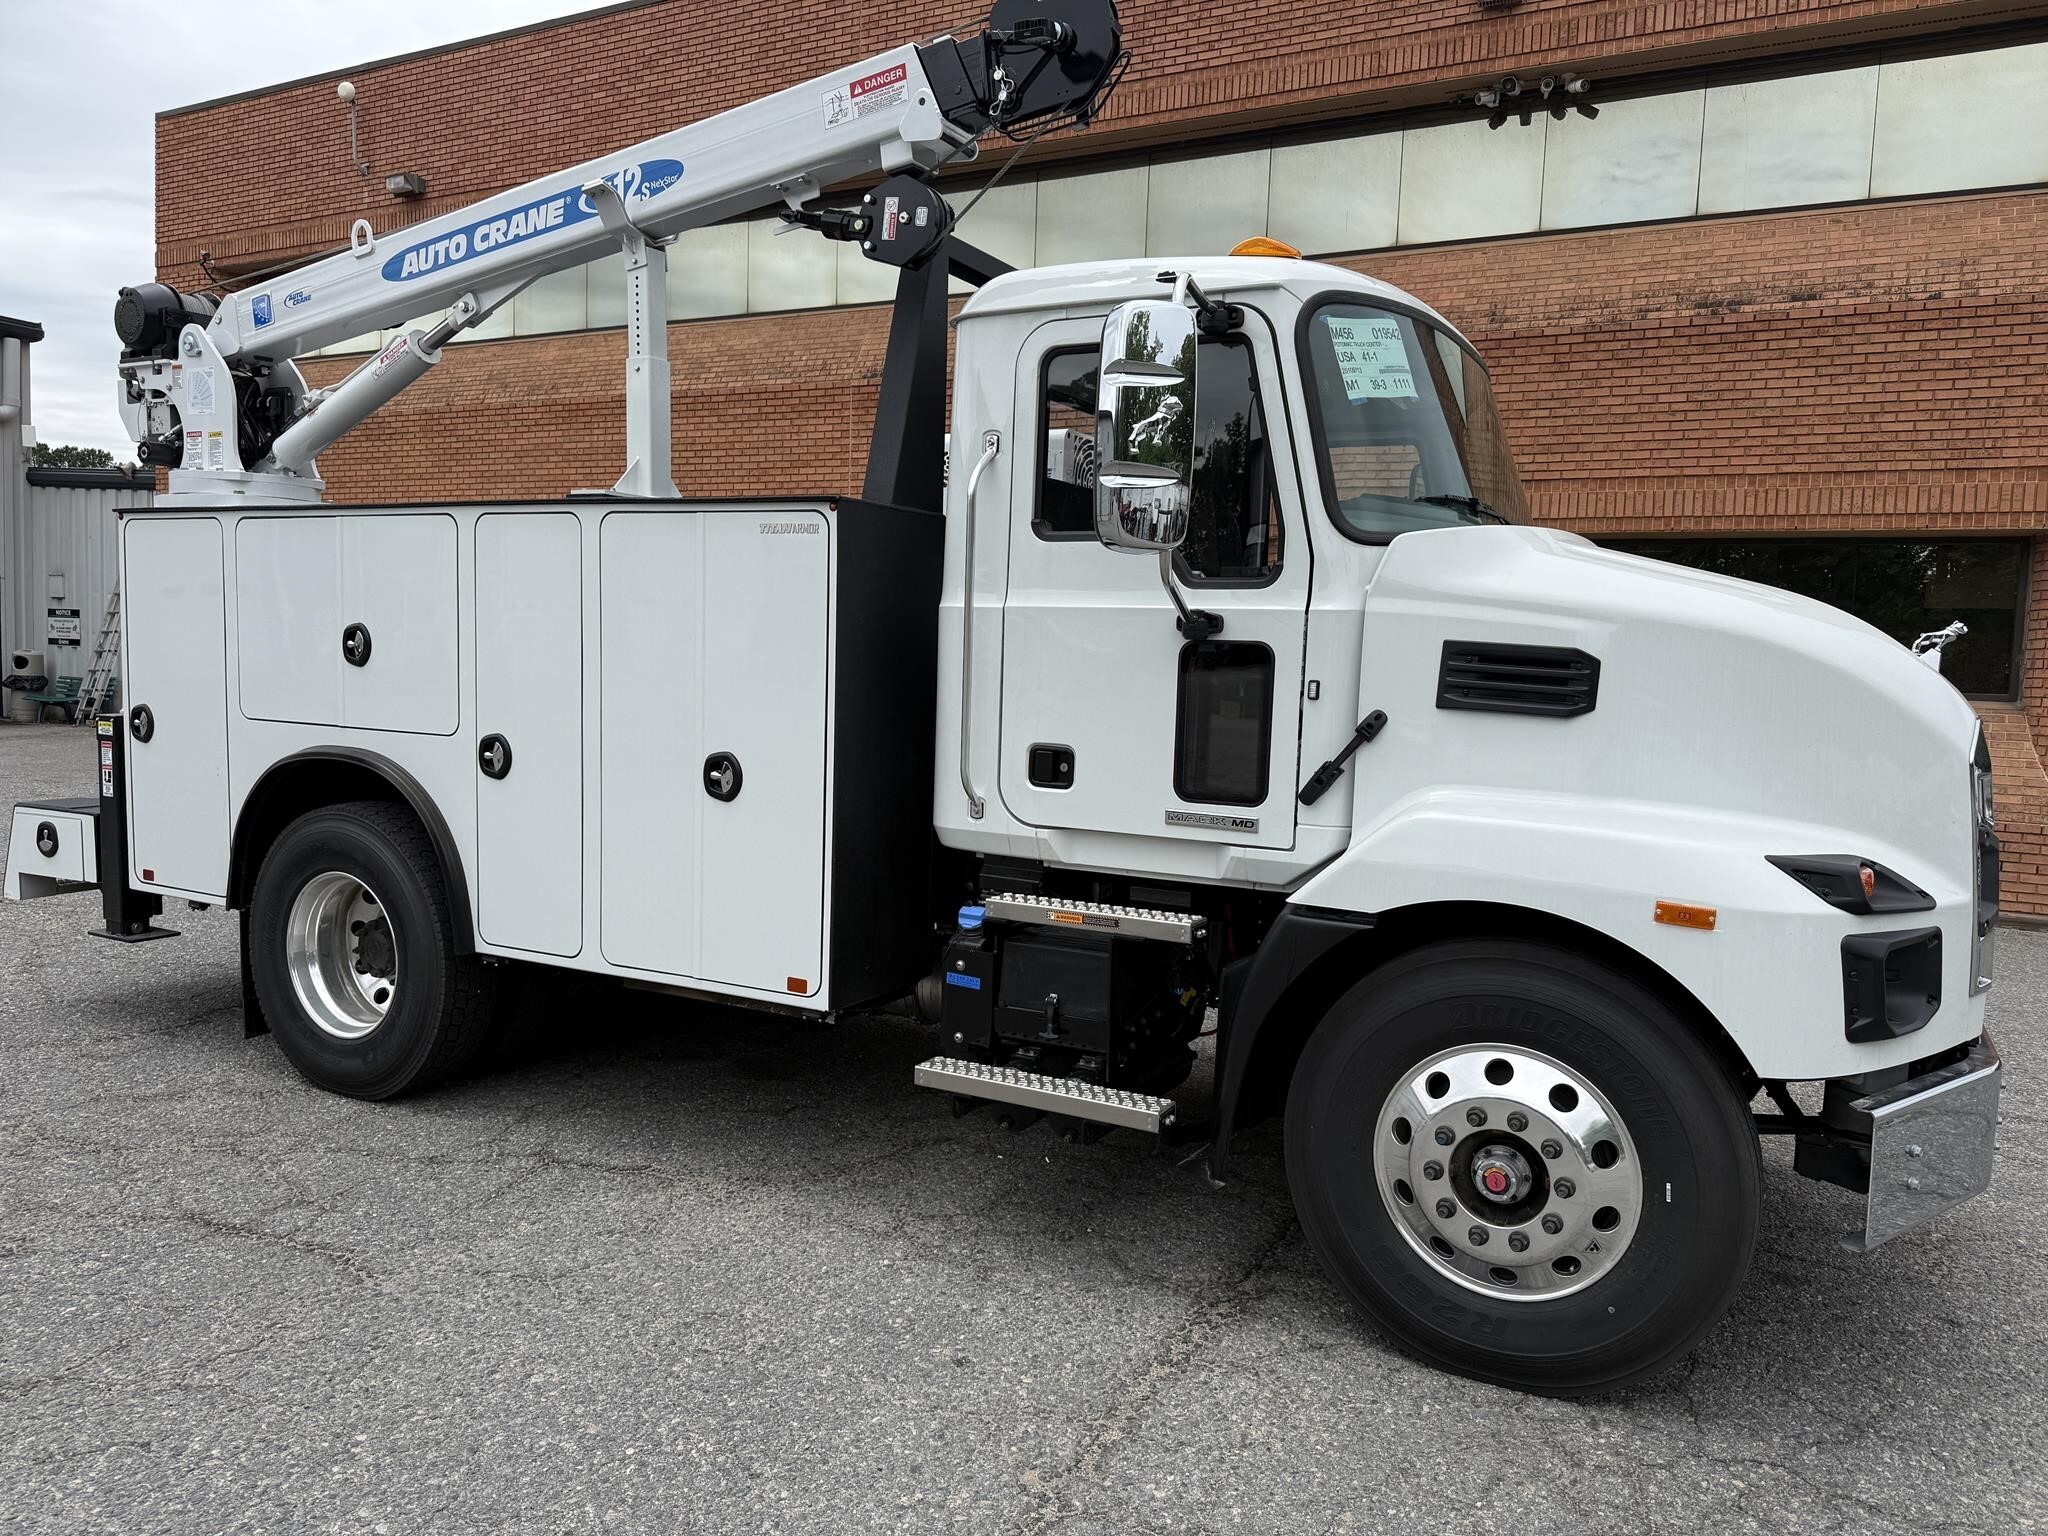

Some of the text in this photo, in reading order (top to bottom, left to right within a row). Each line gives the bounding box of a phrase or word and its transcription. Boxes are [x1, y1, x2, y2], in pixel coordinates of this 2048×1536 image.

[864, 69, 903, 89] DANGER
[400, 232, 468, 279] AUTO
[288, 291, 304, 302] AUTO
[292, 294, 312, 306] CRANE
[1330, 327, 1401, 340] M456 019542
[1336, 351, 1379, 363] USA 41-1
[1345, 379, 1361, 391] M1
[1369, 379, 1388, 390] 39-3
[1167, 812, 1255, 829] MACK MD
[1450, 1001, 1677, 1138] BRIDGESTONE
